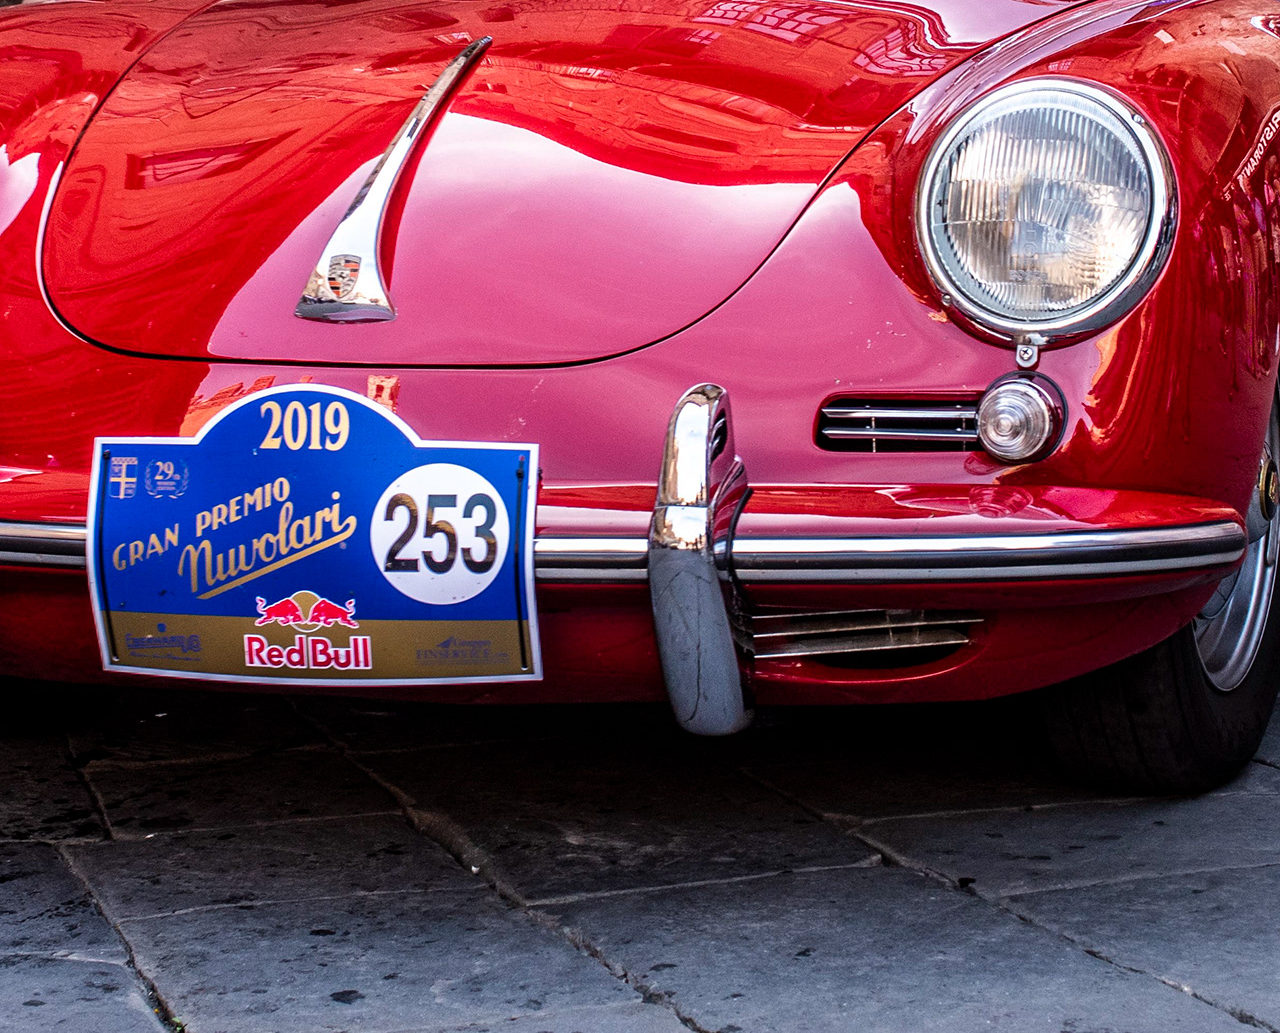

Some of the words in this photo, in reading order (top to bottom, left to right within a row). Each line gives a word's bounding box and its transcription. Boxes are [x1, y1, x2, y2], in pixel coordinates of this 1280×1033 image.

[260, 401, 350, 451] 2019
[113, 523, 180, 571] GRAN
[195, 476, 290, 538] PREMIO
[178, 491, 357, 594] Nuvolari
[383, 493, 497, 573] 253
[244, 635, 306, 668] Red
[310, 637, 372, 669] Bull
